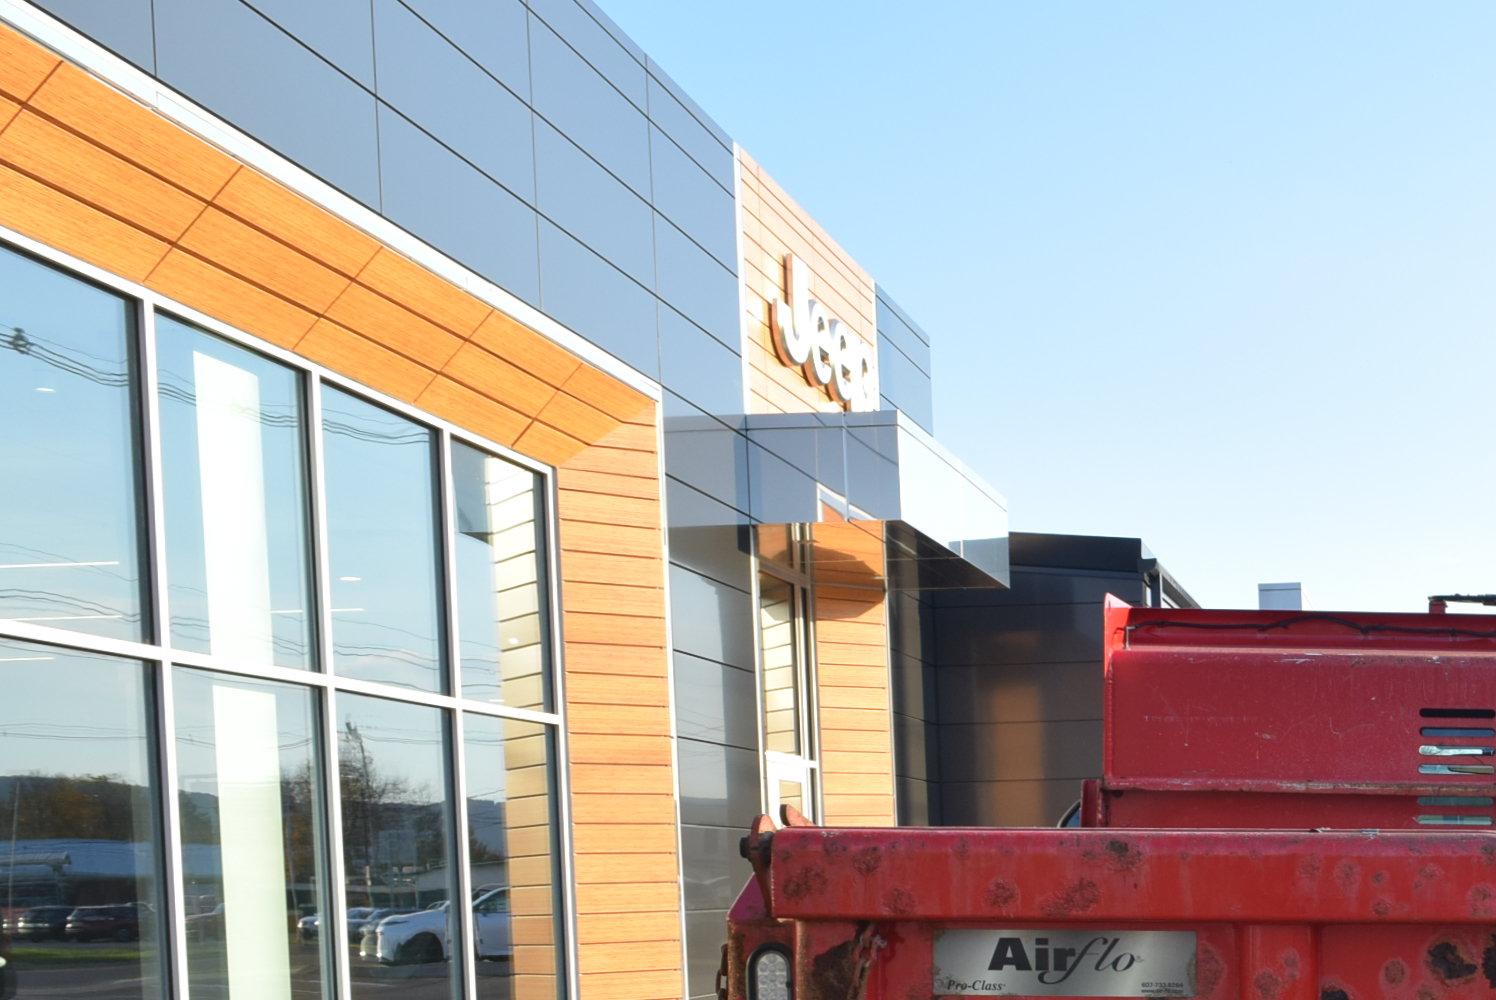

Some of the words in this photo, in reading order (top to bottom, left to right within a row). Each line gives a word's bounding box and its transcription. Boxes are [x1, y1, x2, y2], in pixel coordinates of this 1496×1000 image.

[770, 253, 873, 412] Jeep
[987, 936, 1138, 985] Airflo
[947, 980, 1003, 991] Pro-Class
